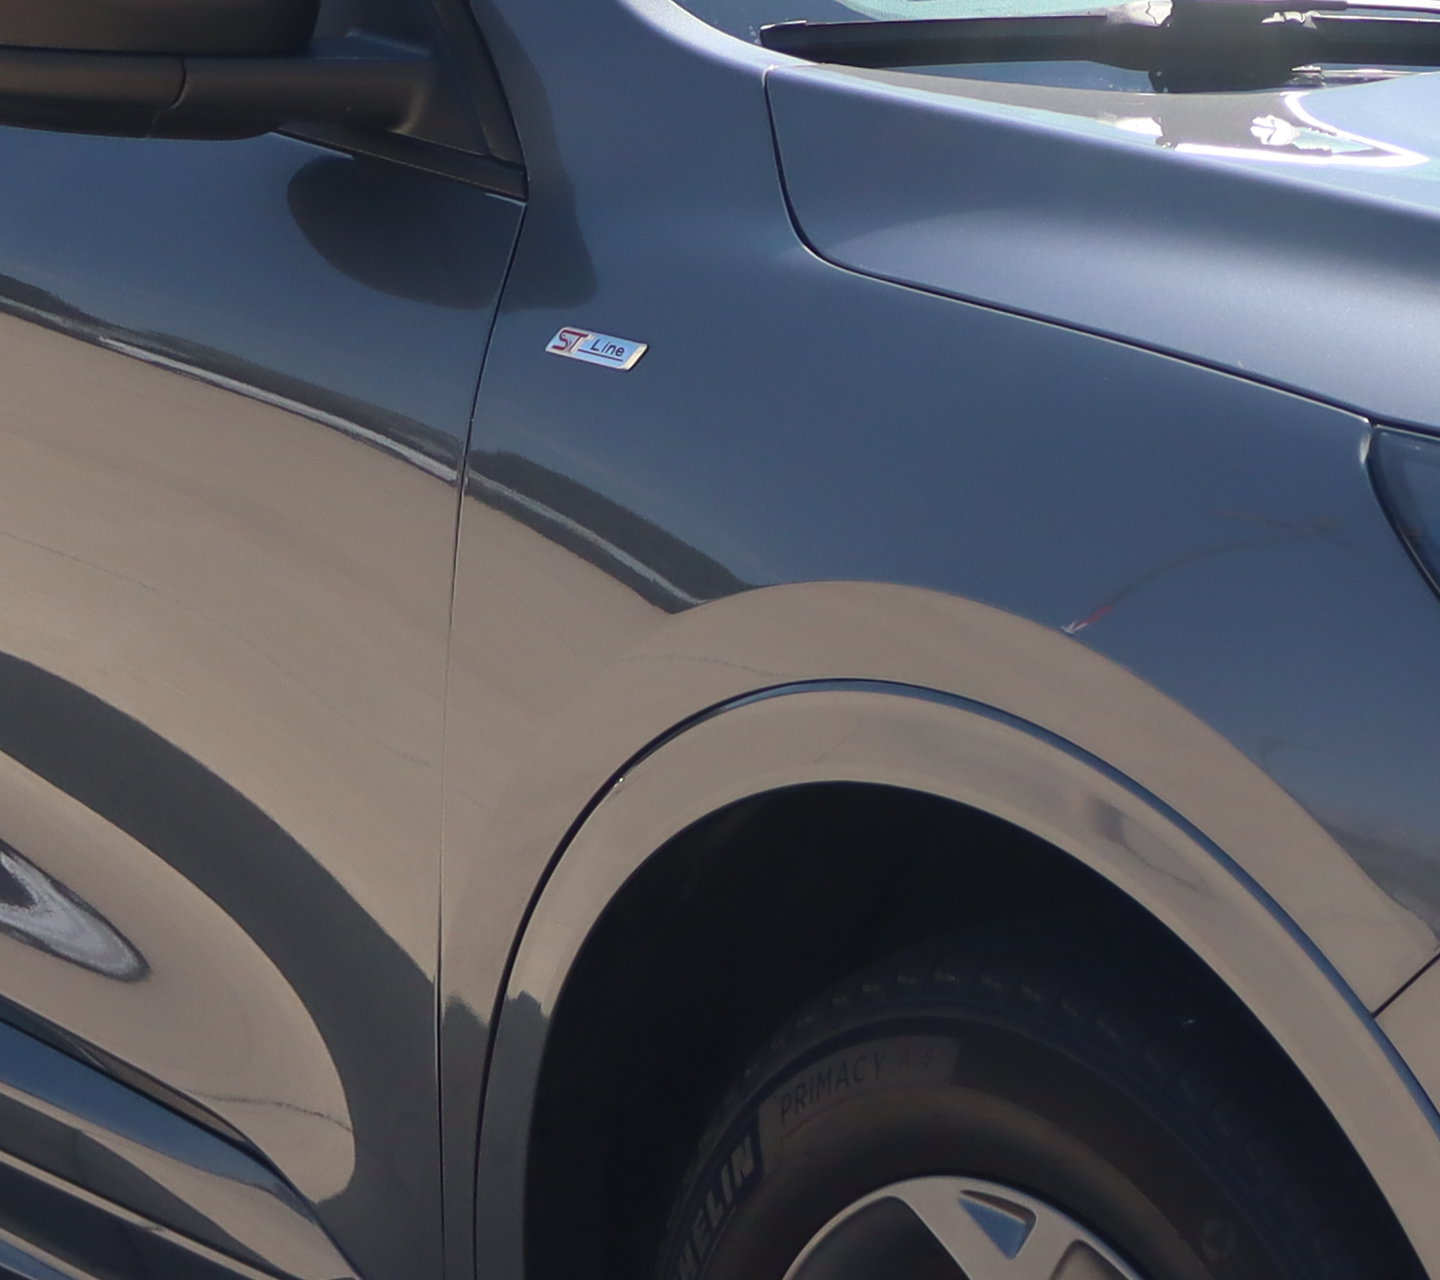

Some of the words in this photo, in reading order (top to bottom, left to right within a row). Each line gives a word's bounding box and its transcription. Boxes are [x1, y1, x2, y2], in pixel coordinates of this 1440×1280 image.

[551, 329, 589, 352] ST
[590, 338, 625, 357] Line
[780, 1049, 888, 1125] PRIMACY
